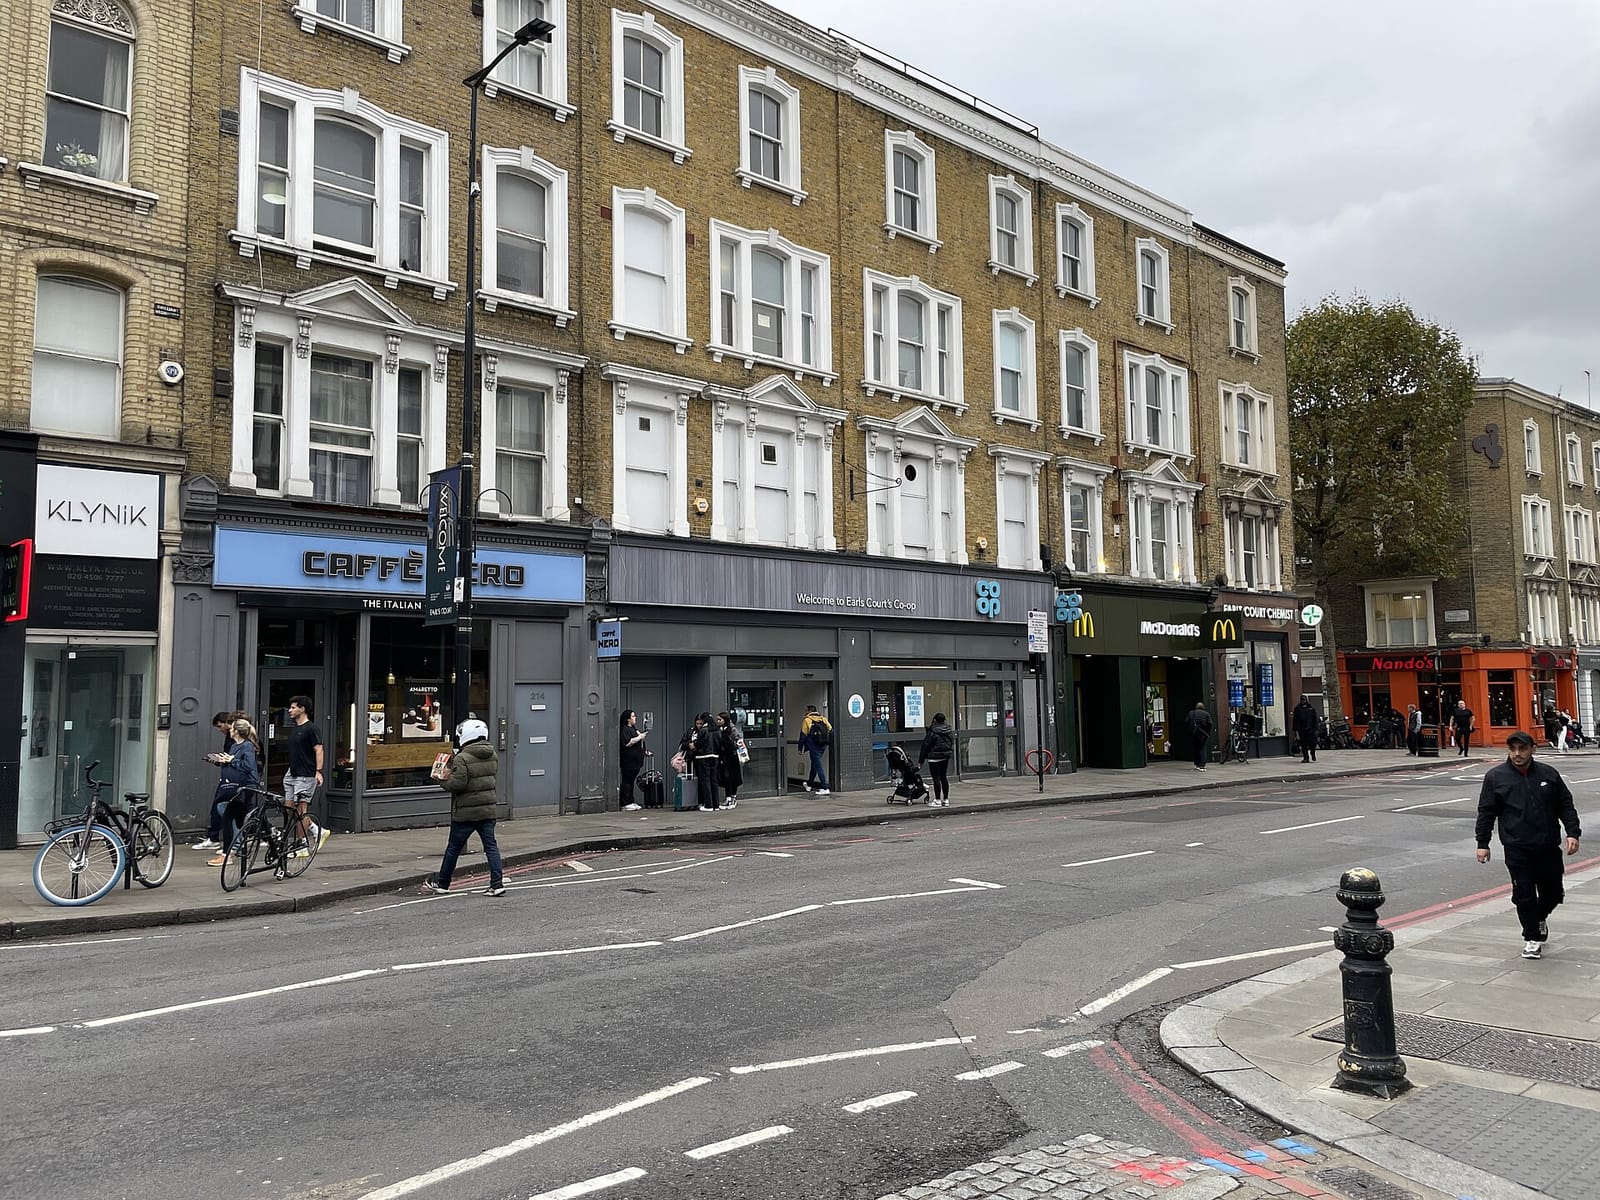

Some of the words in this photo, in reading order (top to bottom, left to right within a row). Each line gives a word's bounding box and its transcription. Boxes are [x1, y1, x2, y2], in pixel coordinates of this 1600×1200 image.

[438, 484, 449, 573] WELCOME
[303, 549, 424, 582] CAFFÈ
[471, 562, 525, 587] RO
[363, 600, 381, 608] THE
[384, 600, 422, 610] ITALIAN
[796, 592, 835, 606] Welcome
[836, 596, 845, 606] to
[846, 596, 865, 608] Earls
[866, 597, 893, 609] Court's
[893, 599, 917, 613] Co-op
[1243, 606, 1266, 618] COURT
[1266, 608, 1294, 620] CHEMIST
[1140, 621, 1200, 637] McDonald's
[598, 639, 619, 649] NERO
[1372, 655, 1434, 670] Nando's
